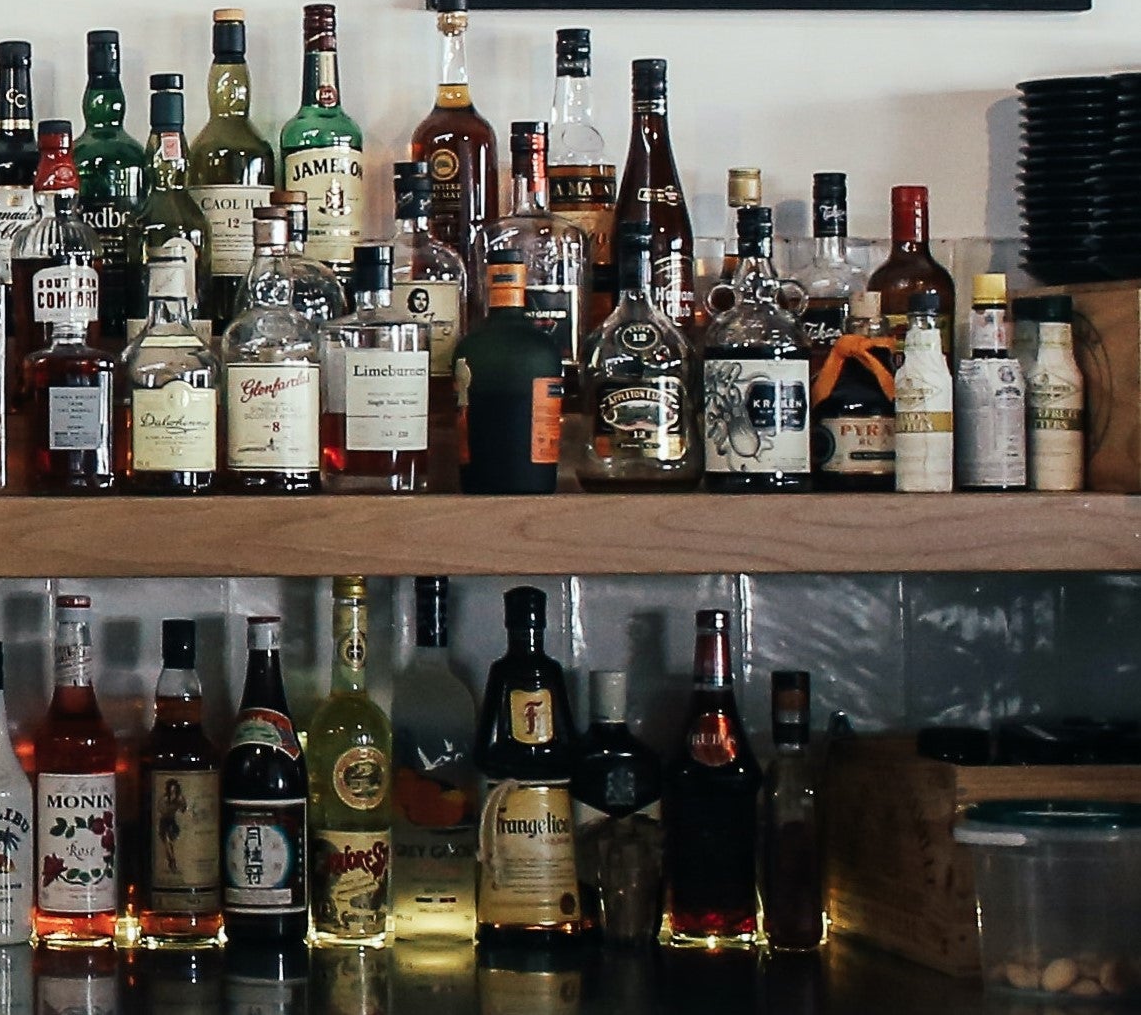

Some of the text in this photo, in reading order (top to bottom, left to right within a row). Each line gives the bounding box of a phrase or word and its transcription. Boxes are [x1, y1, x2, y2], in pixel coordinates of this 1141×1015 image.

[200, 197, 240, 211] CAOL
[227, 217, 240, 229] 12
[271, 421, 281, 433] 8
[46, 794, 114, 810] MONIN
